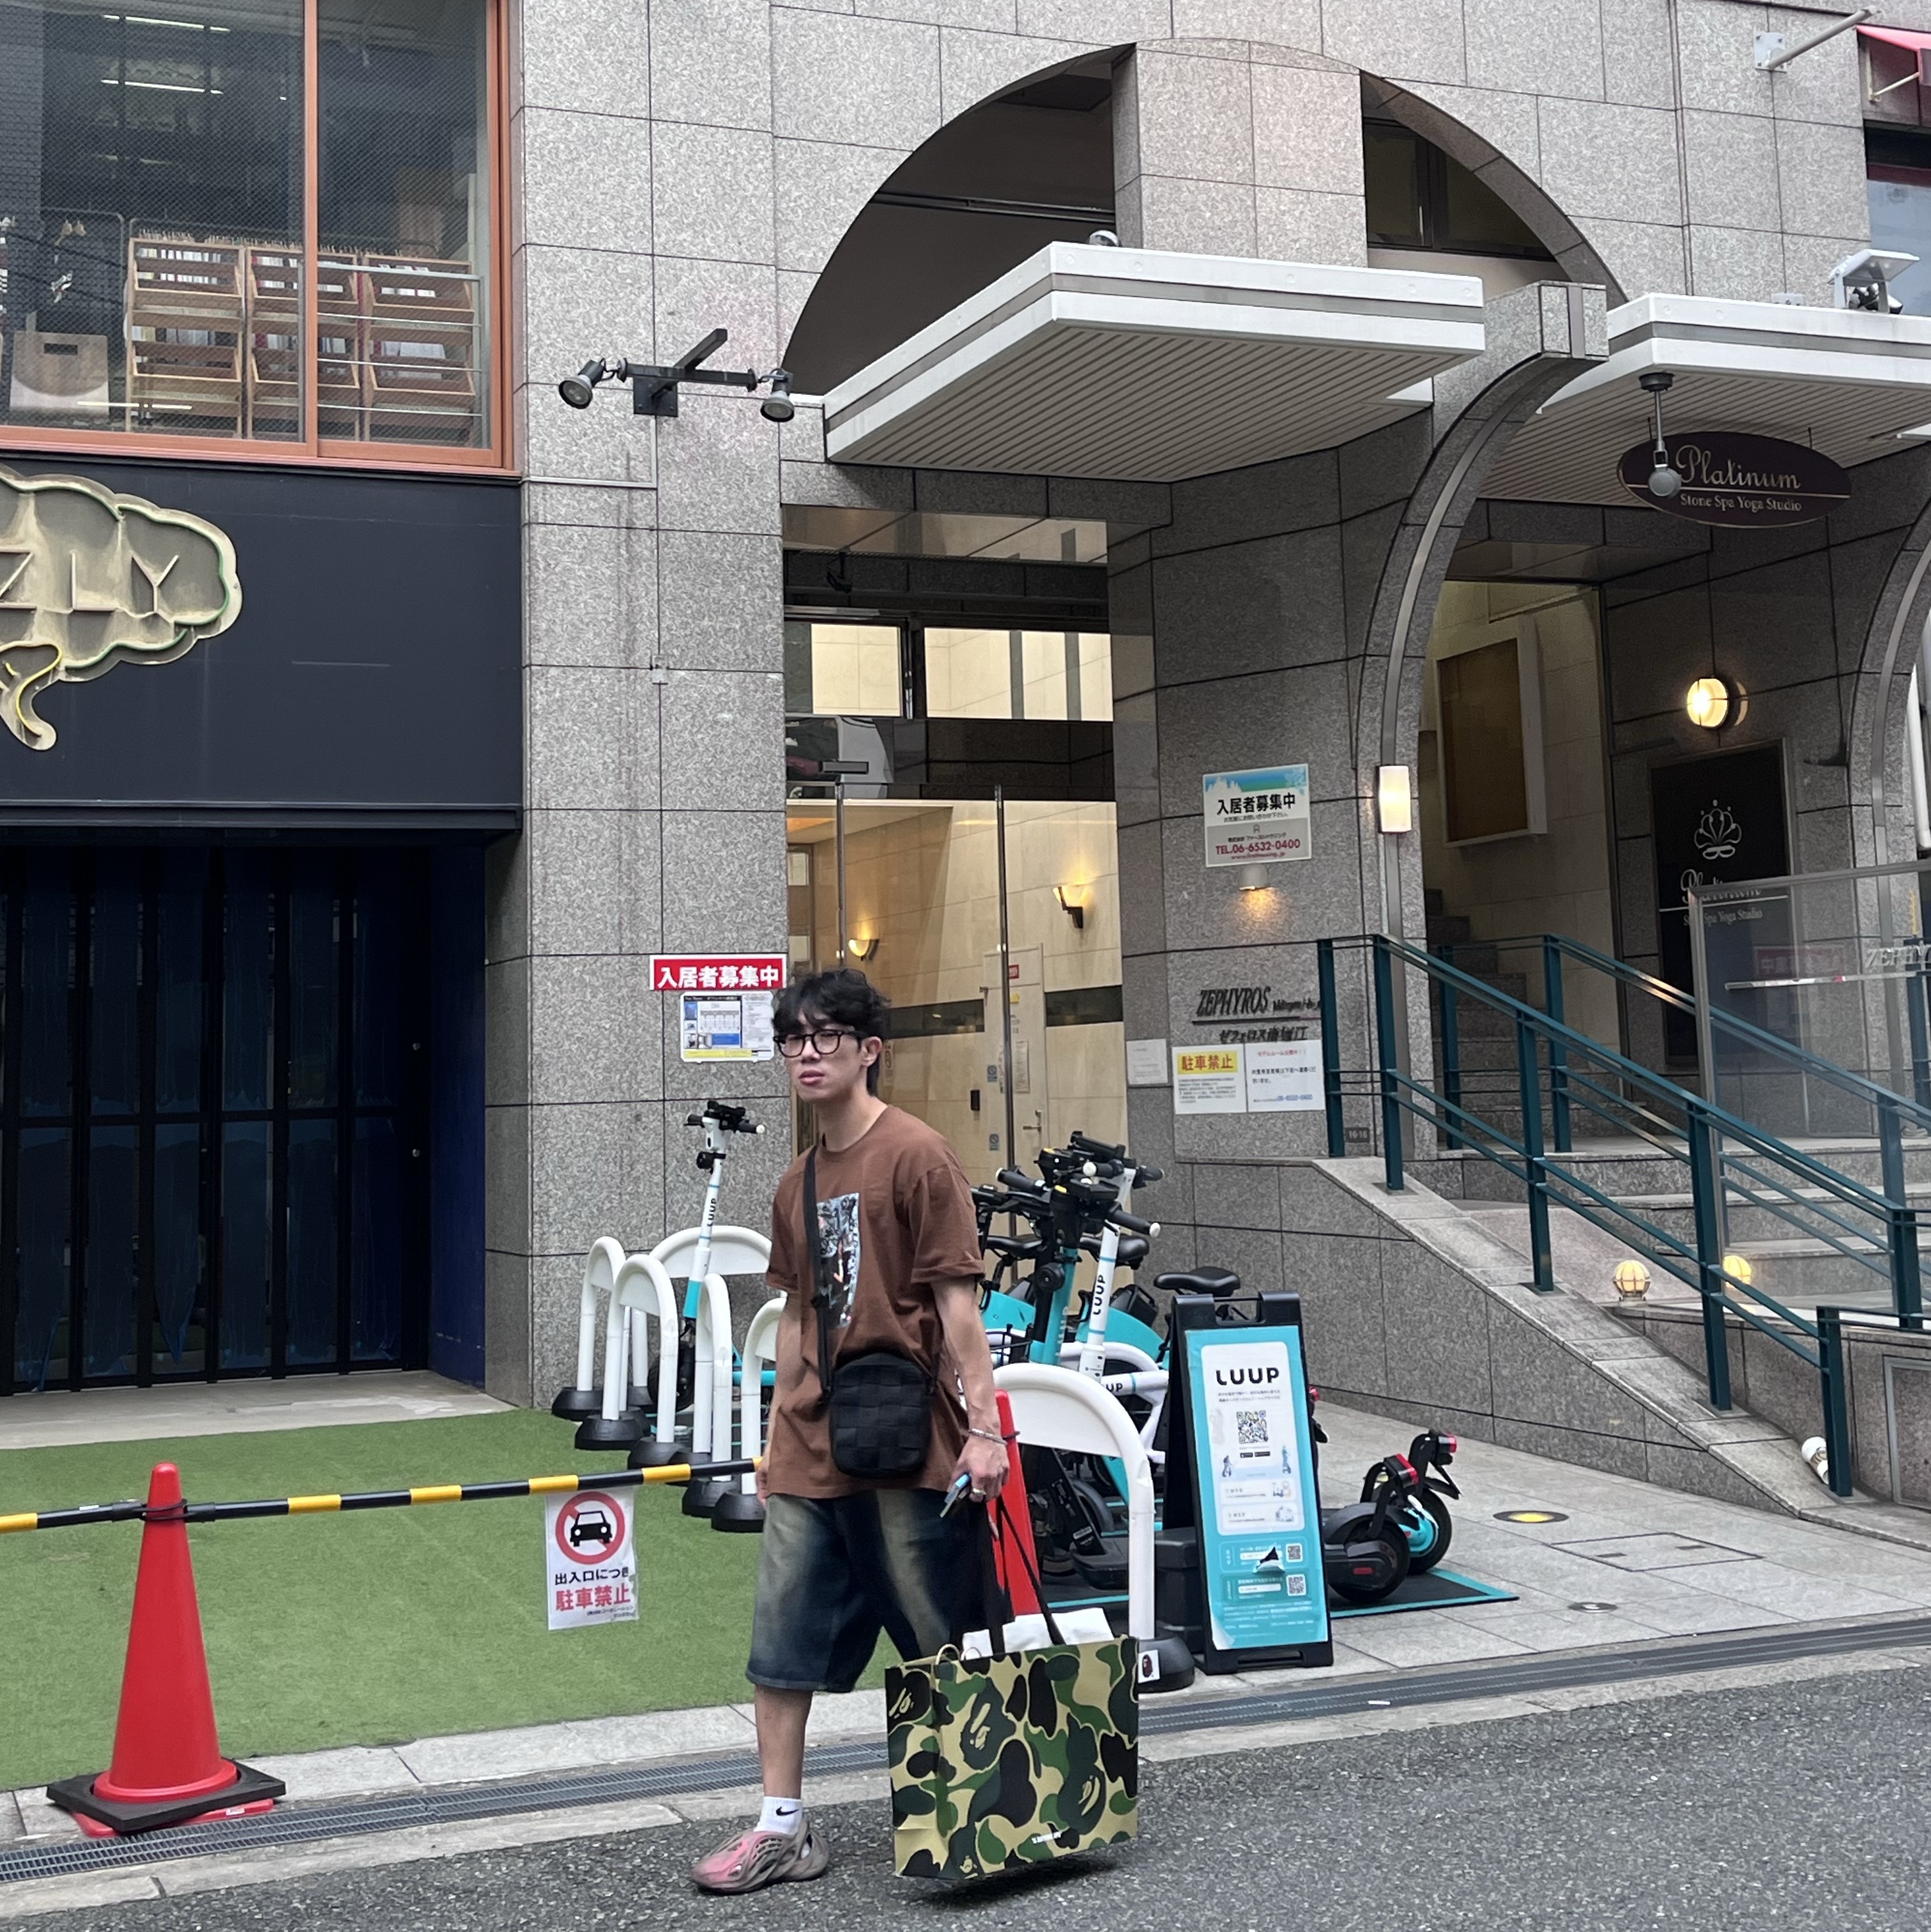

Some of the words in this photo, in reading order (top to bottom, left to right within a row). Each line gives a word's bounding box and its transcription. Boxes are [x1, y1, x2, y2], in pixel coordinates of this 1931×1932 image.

[1675, 445, 1801, 489] Platinum
[1681, 494, 1712, 507] Stone
[1714, 495, 1735, 511] Spa
[1737, 496, 1764, 513] Yoga
[1766, 498, 1802, 512] Studio
[1217, 792, 1295, 815] 入居者募集中
[1216, 839, 1301, 855] TEL.06-6532-0400
[657, 965, 779, 988] 入居者募集中
[1196, 986, 1271, 1017] ZEPHYROS
[1182, 1054, 1233, 1071] 駐車禁止
[706, 1198, 717, 1227] LUUP
[1093, 1275, 1106, 1315] LUUP
[1216, 1367, 1279, 1386] LUUP
[556, 1583, 630, 1611] 駐車禁止
